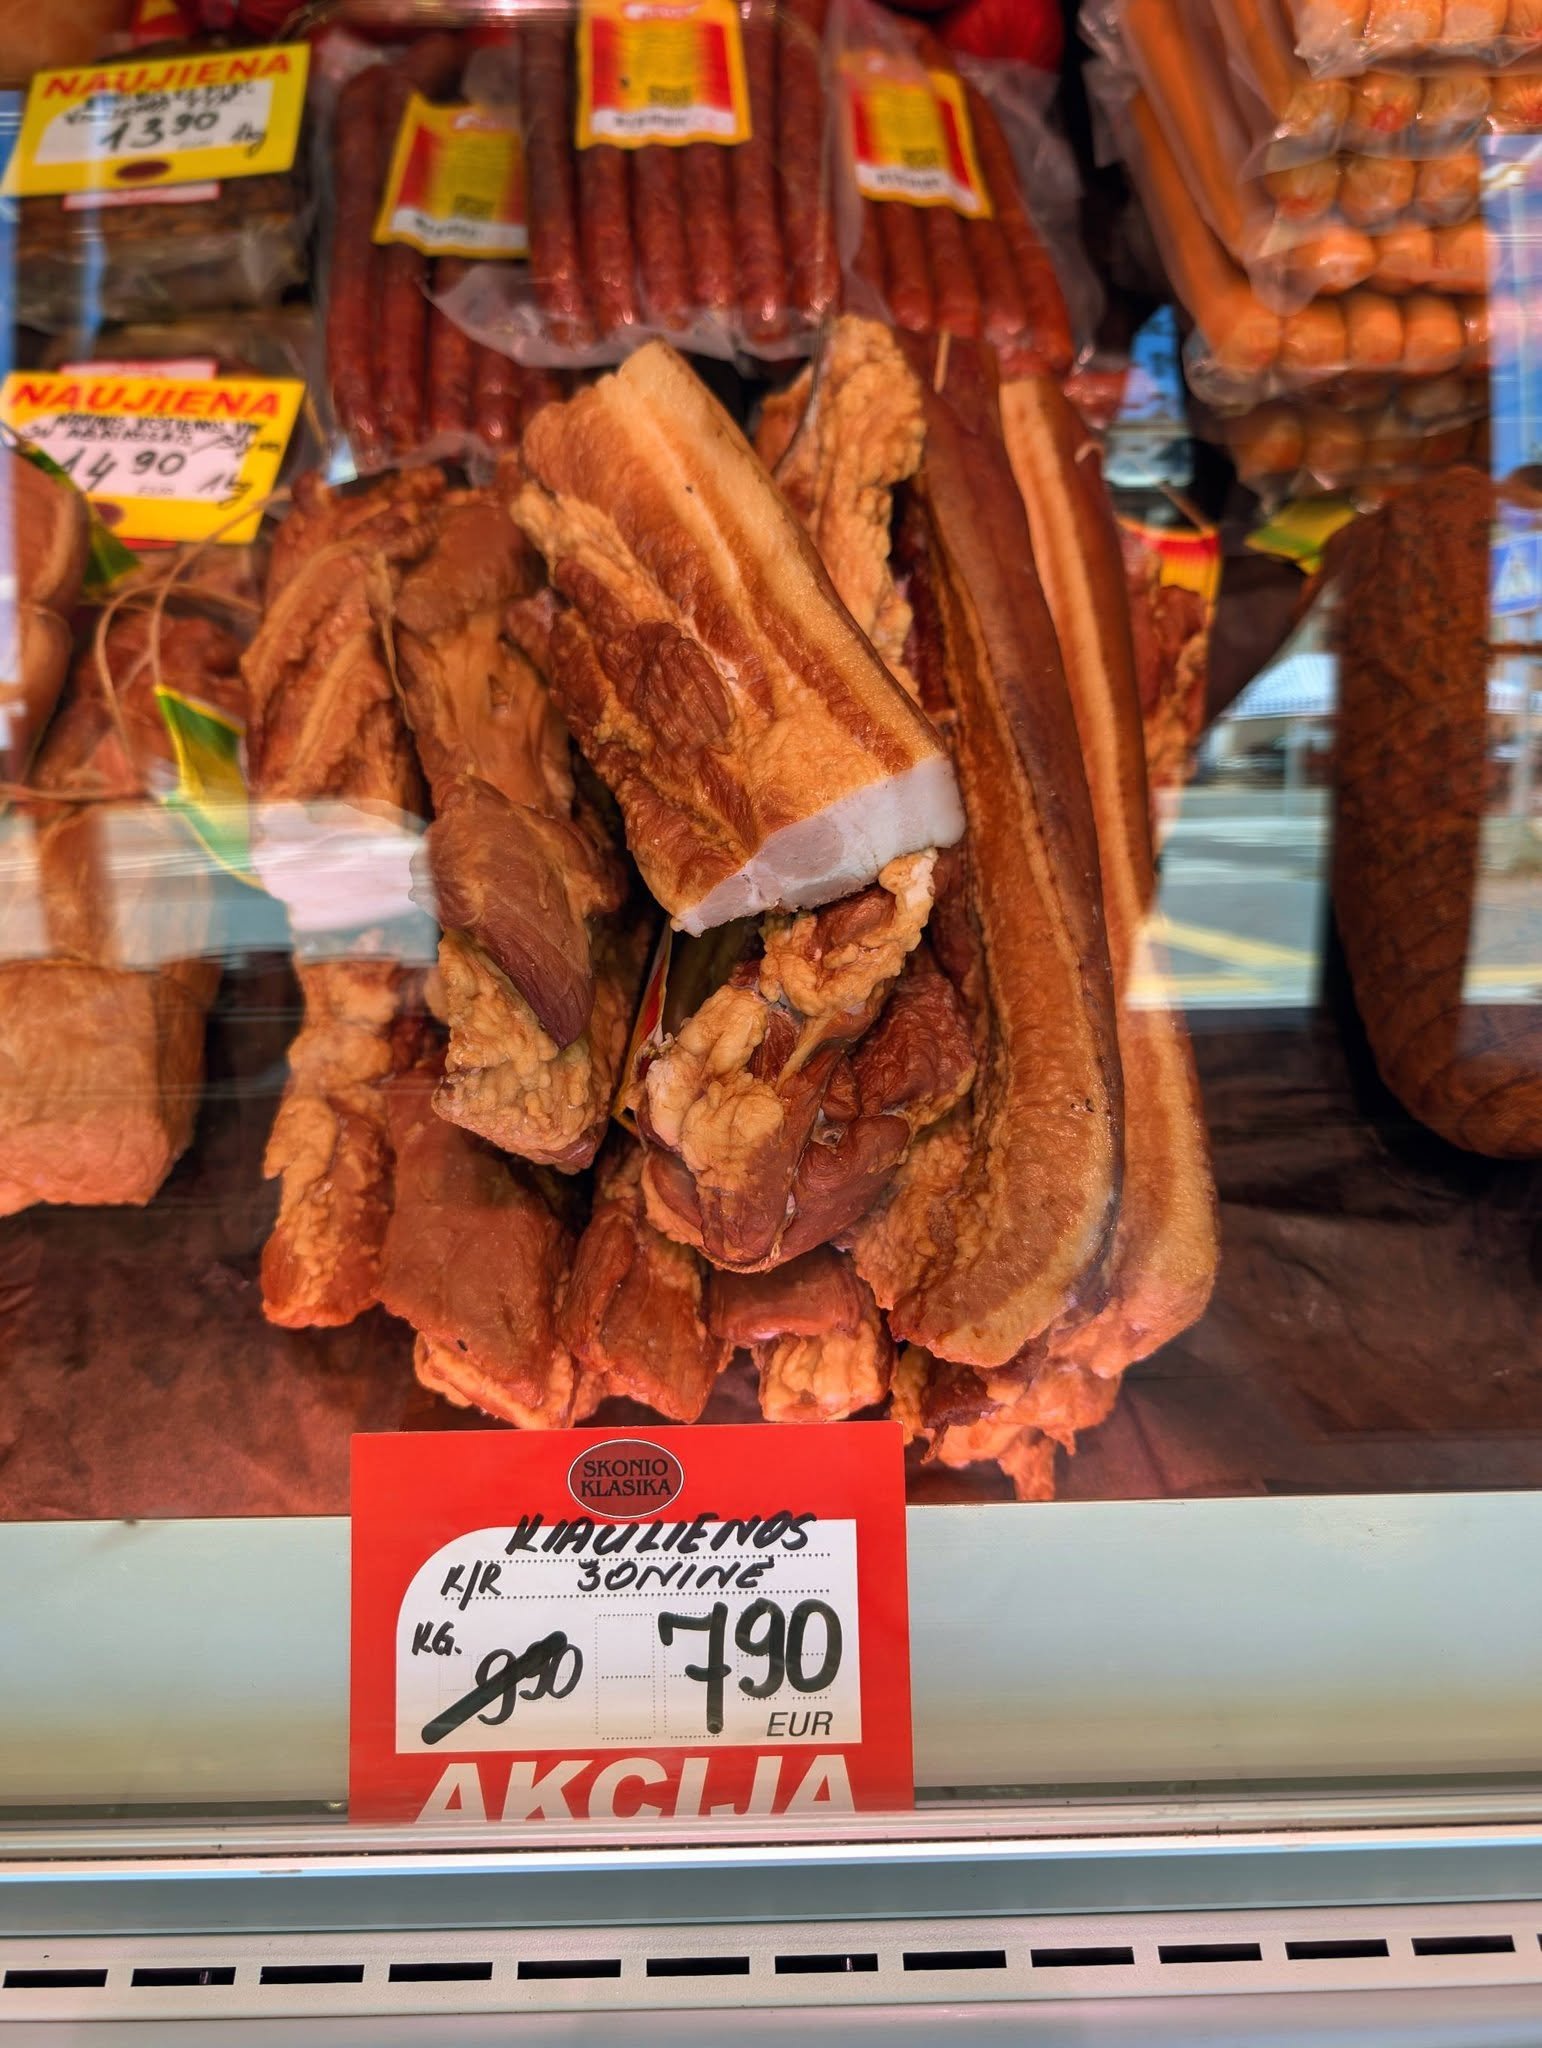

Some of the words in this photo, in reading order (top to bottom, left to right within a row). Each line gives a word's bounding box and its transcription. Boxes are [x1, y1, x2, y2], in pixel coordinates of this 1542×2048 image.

[44, 53, 292, 99] NAUJIENA
[11, 382, 281, 418] NAUJIENA
[581, 1478, 672, 1497] KLASIKA
[583, 1458, 668, 1477] SKONIO
[440, 1560, 502, 1611] K/R
[658, 1597, 843, 1734] 790
[766, 1710, 834, 1737] EUR
[414, 1754, 856, 1824] AKCIJA
